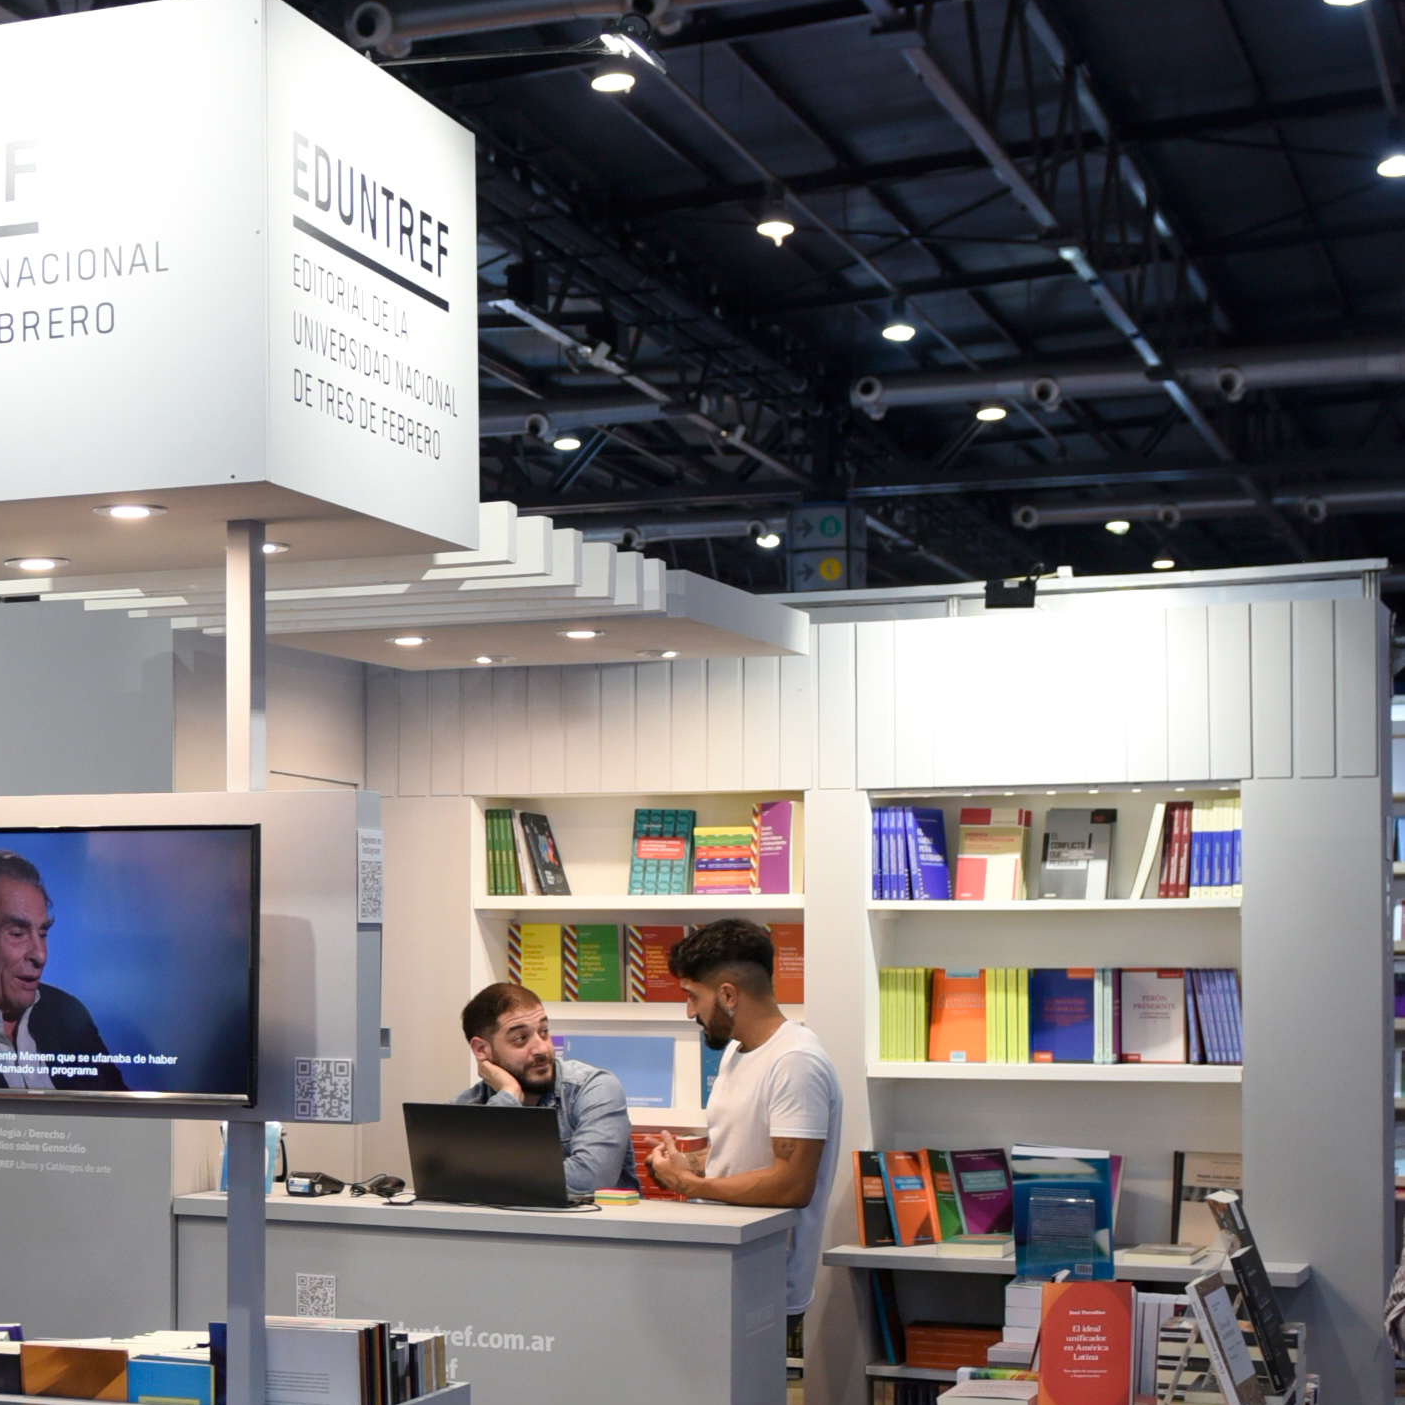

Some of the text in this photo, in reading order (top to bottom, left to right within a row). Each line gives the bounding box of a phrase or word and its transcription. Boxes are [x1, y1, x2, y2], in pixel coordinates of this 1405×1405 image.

[293, 130, 449, 279] EDUNTREF
[294, 253, 409, 343] EDITORIAL DE LA
[294, 310, 458, 418] UNIVERSIDAD NACIONAL
[294, 368, 441, 461] DE TRES DE FEBRERO
[20, 1052, 55, 1061] Menem
[57, 1054, 76, 1064] que
[78, 1054, 90, 1062] se
[92, 1053, 131, 1063] ufanaba
[133, 1054, 146, 1064] de
[148, 1054, 178, 1065] haber
[37, 1066, 49, 1074] un
[51, 1066, 98, 1078] programa
[29, 1129, 66, 1140] Derecho
[16, 1141, 41, 1151] sobre
[42, 1143, 86, 1154] Genocidio
[16, 1161, 39, 1170] Libros
[46, 1161, 84, 1173] Catálogos
[85, 1164, 94, 1173] de
[95, 1165, 112, 1174] arte
[1082, 1325, 1102, 1333] ideal
[393, 1321, 555, 1352] ref.com.ar
[1066, 1334, 1107, 1342] unificador
[1075, 1344, 1109, 1352] América
[1073, 1353, 1099, 1361] Latina
